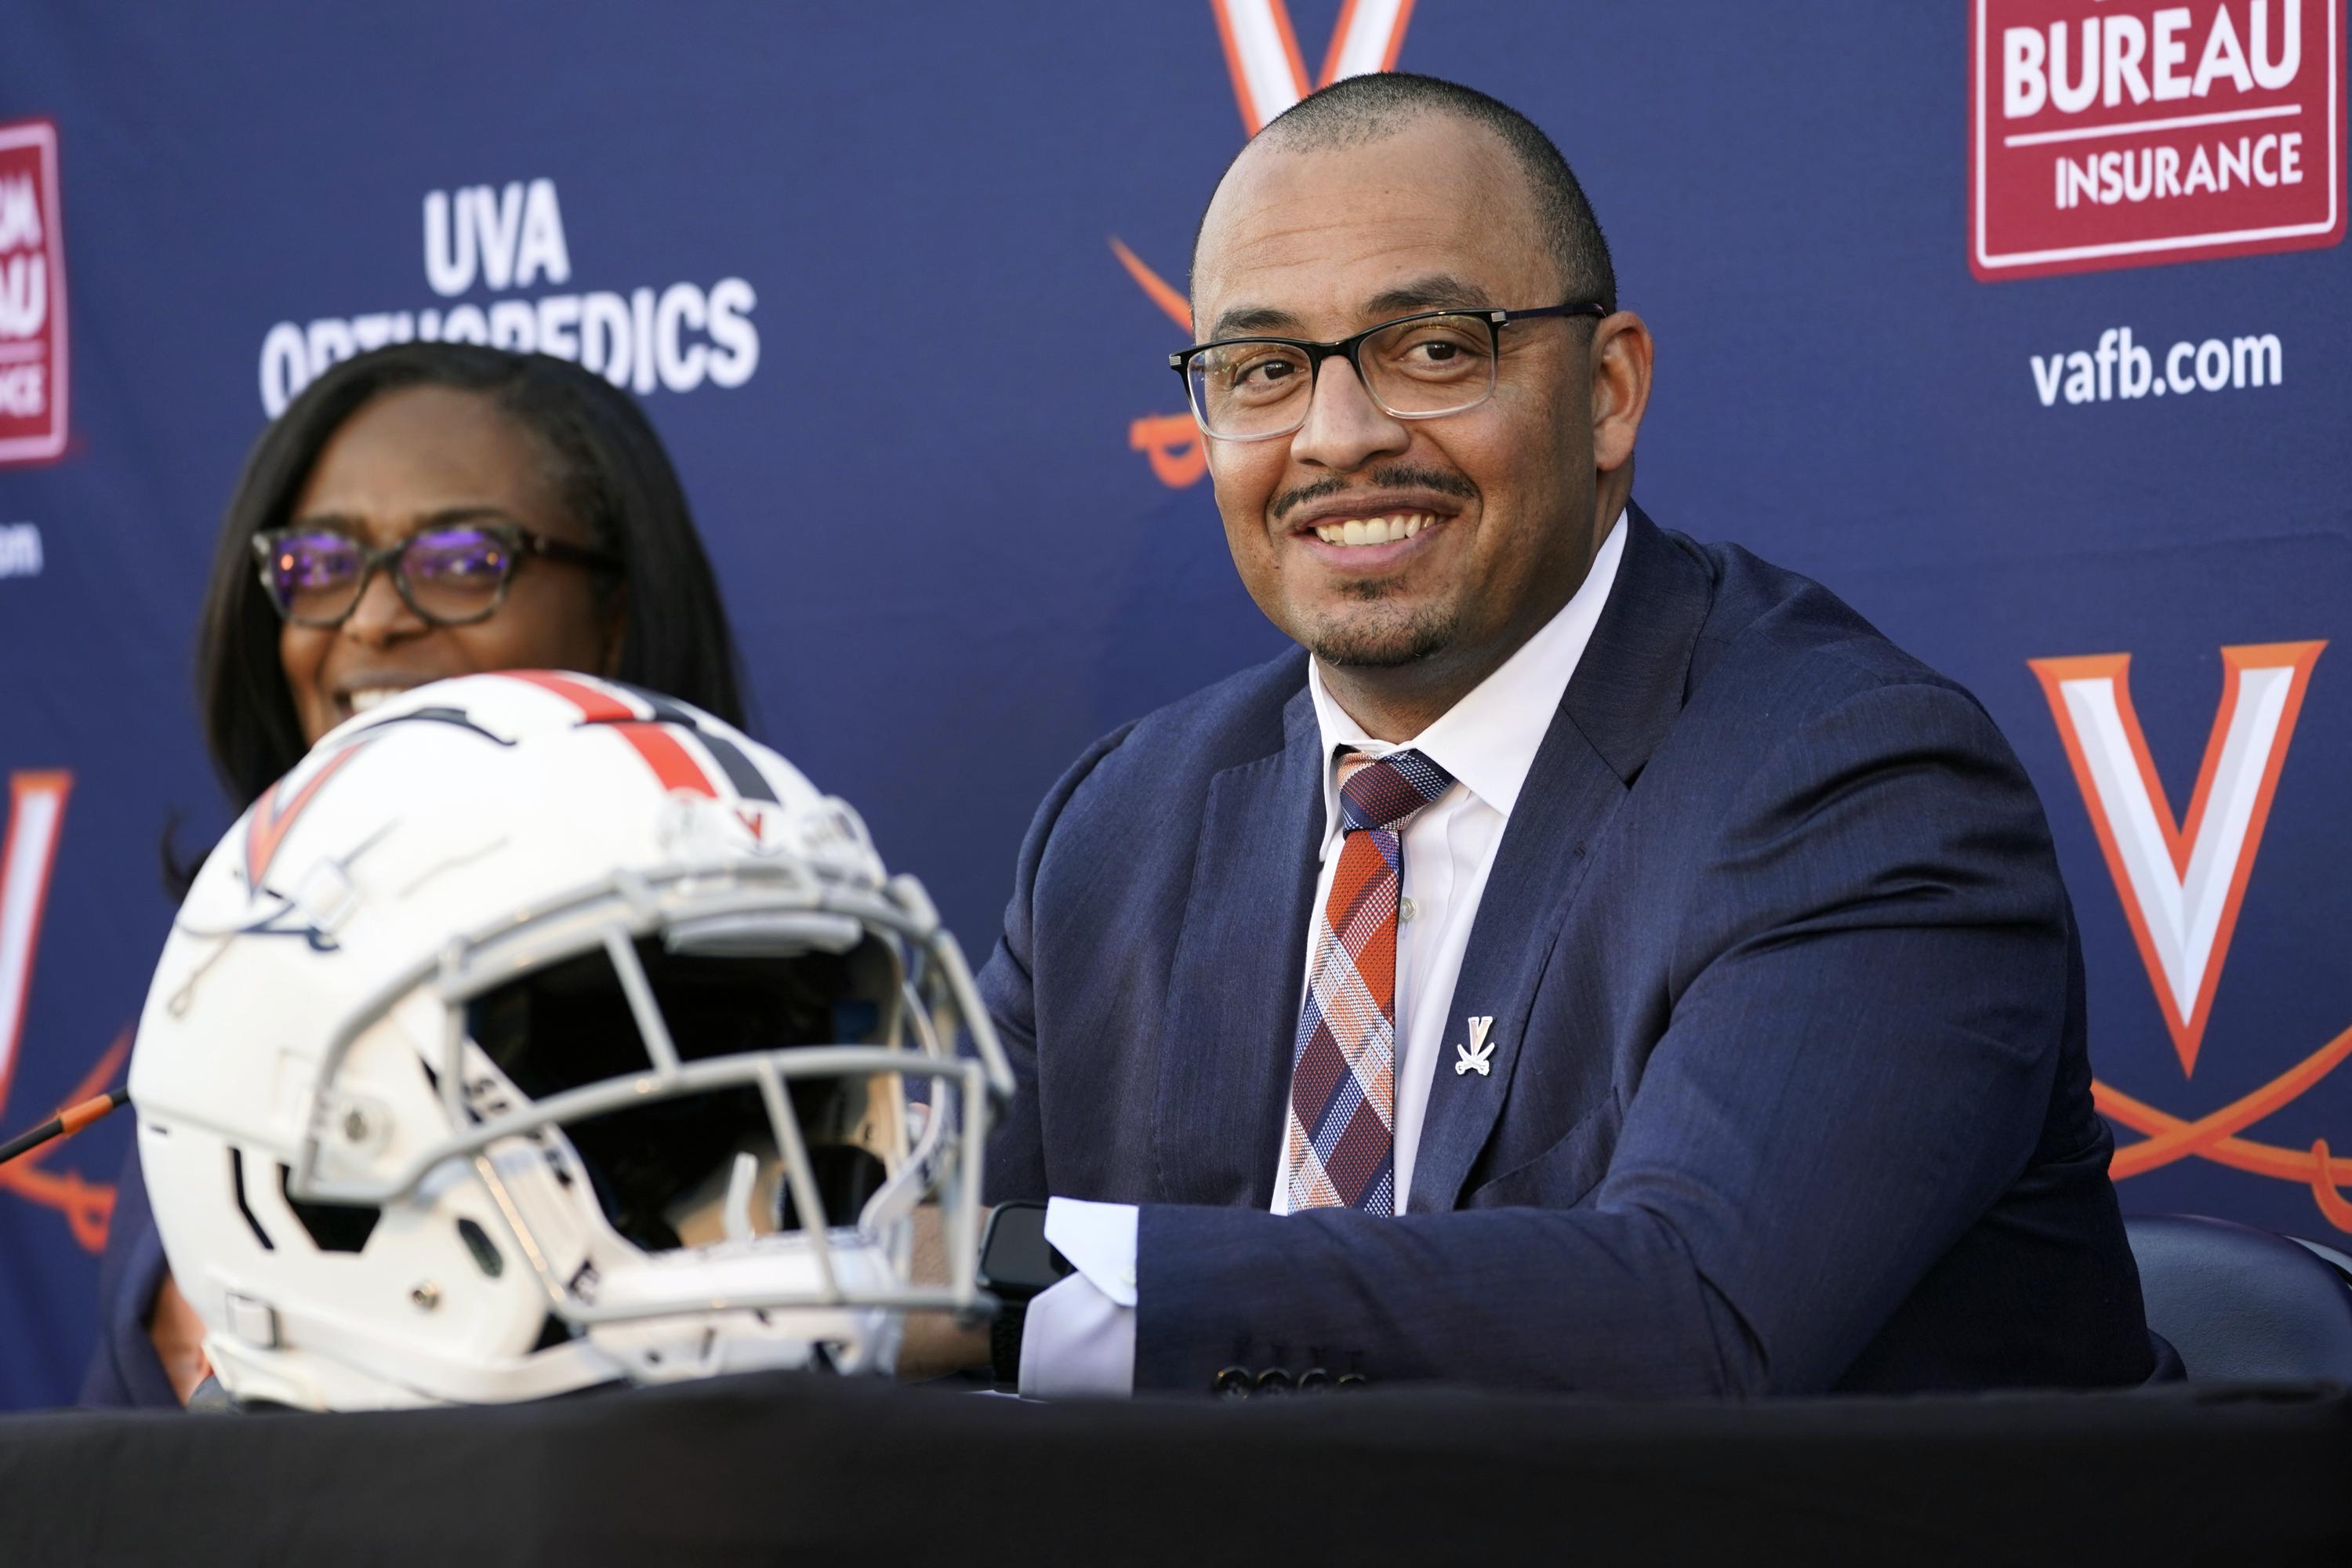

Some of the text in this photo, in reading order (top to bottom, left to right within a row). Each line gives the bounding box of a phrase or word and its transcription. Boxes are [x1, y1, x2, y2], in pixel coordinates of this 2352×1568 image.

[2004, 0, 2301, 118] BUREAU
[2056, 132, 2303, 209] INSURANCE
[423, 178, 571, 296] UVA
[2030, 327, 2282, 407] vafb.com
